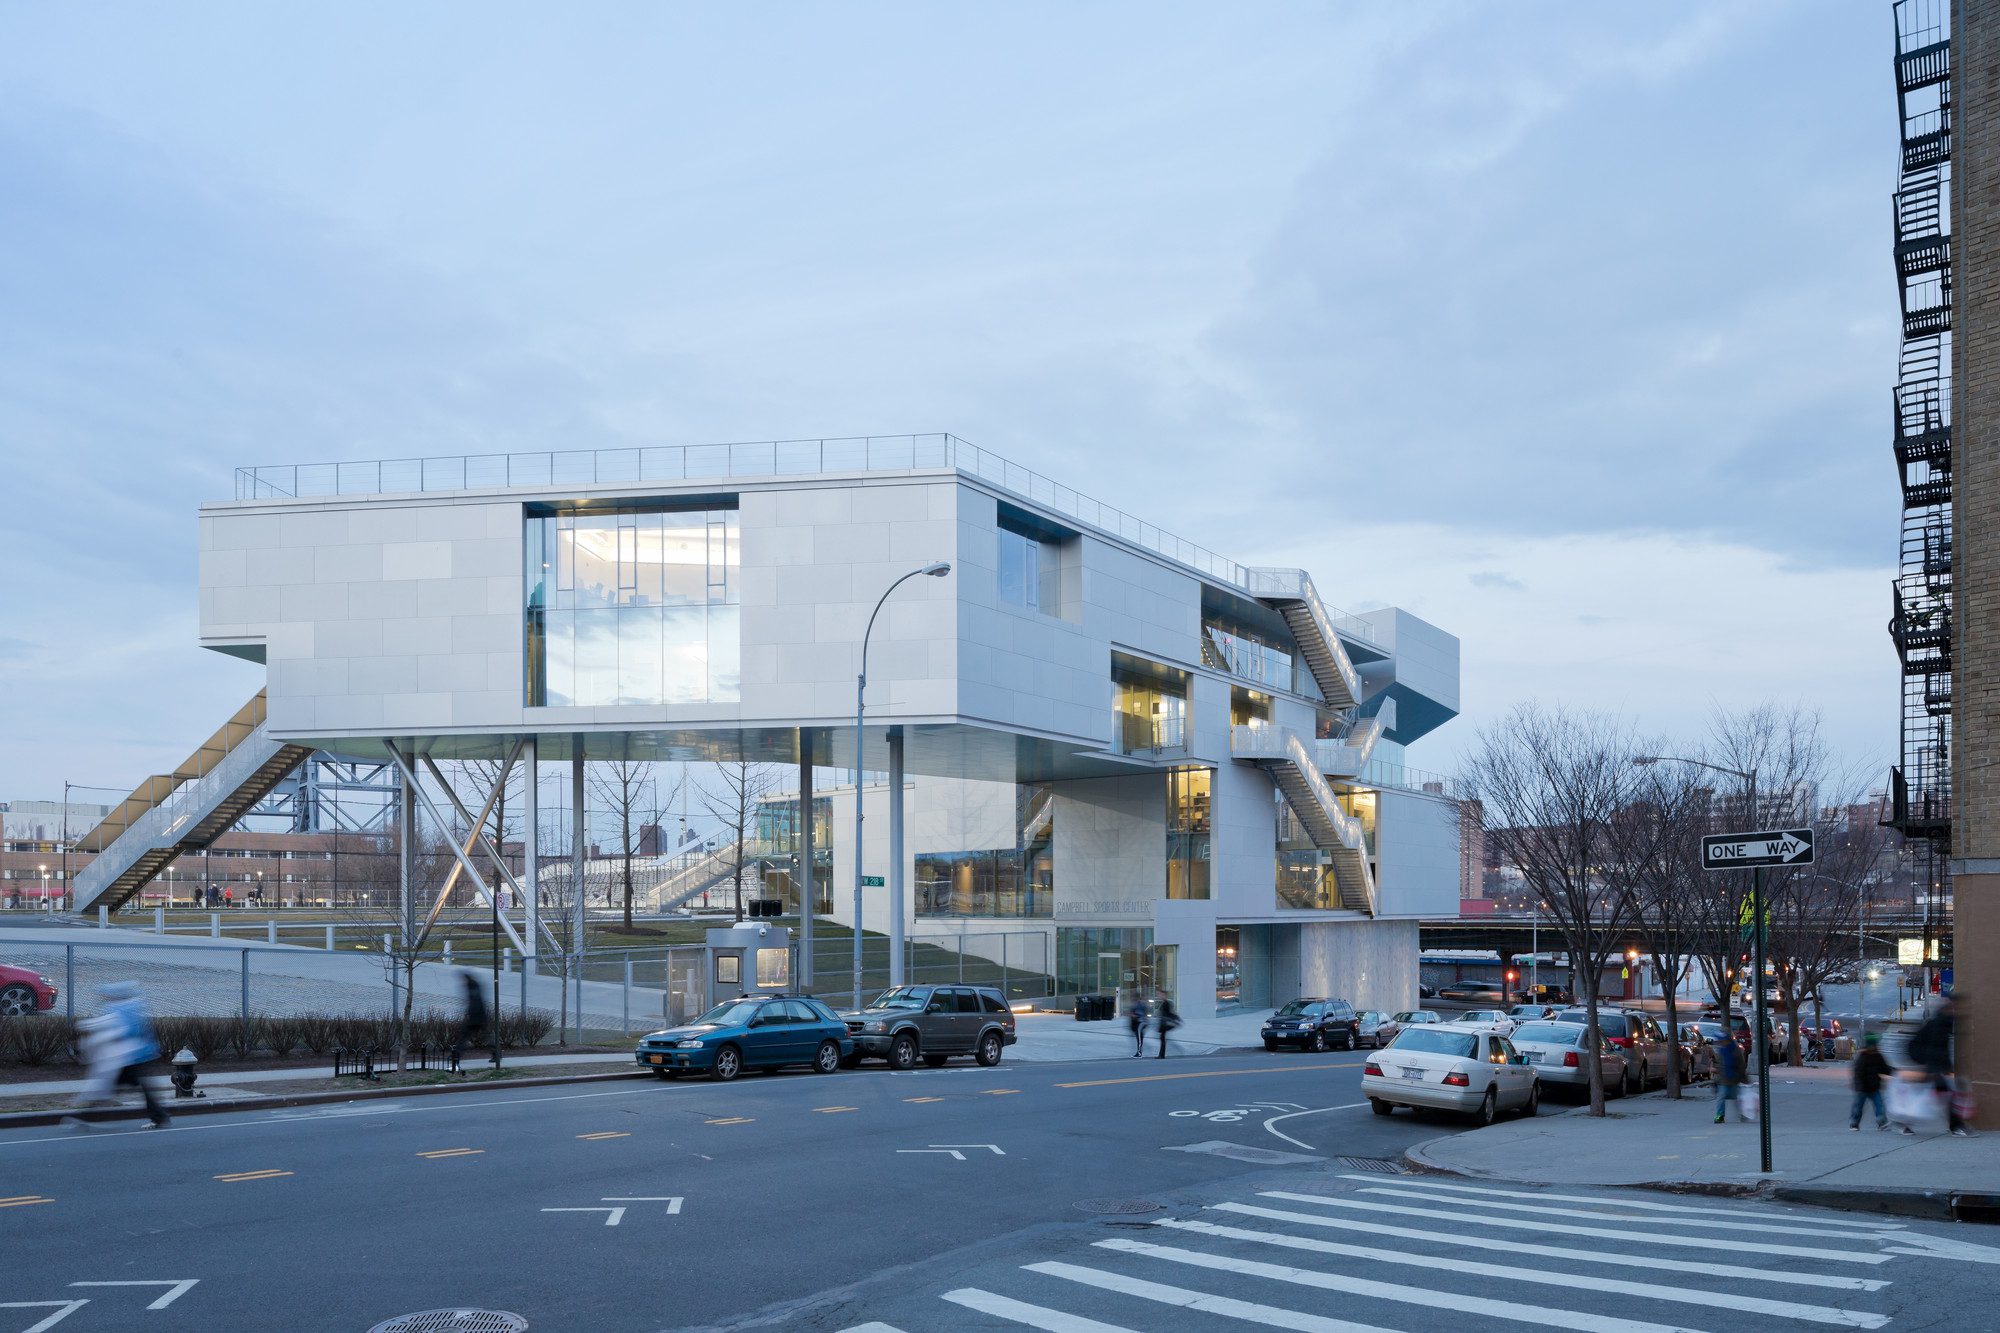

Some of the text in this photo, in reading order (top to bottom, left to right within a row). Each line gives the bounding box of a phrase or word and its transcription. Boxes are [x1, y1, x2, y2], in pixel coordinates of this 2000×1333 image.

[1712, 841, 1800, 858] ONE WAY
[869, 877, 879, 886] 218
[1057, 900, 1150, 913] CAMPBELL SPORTS CENTER
